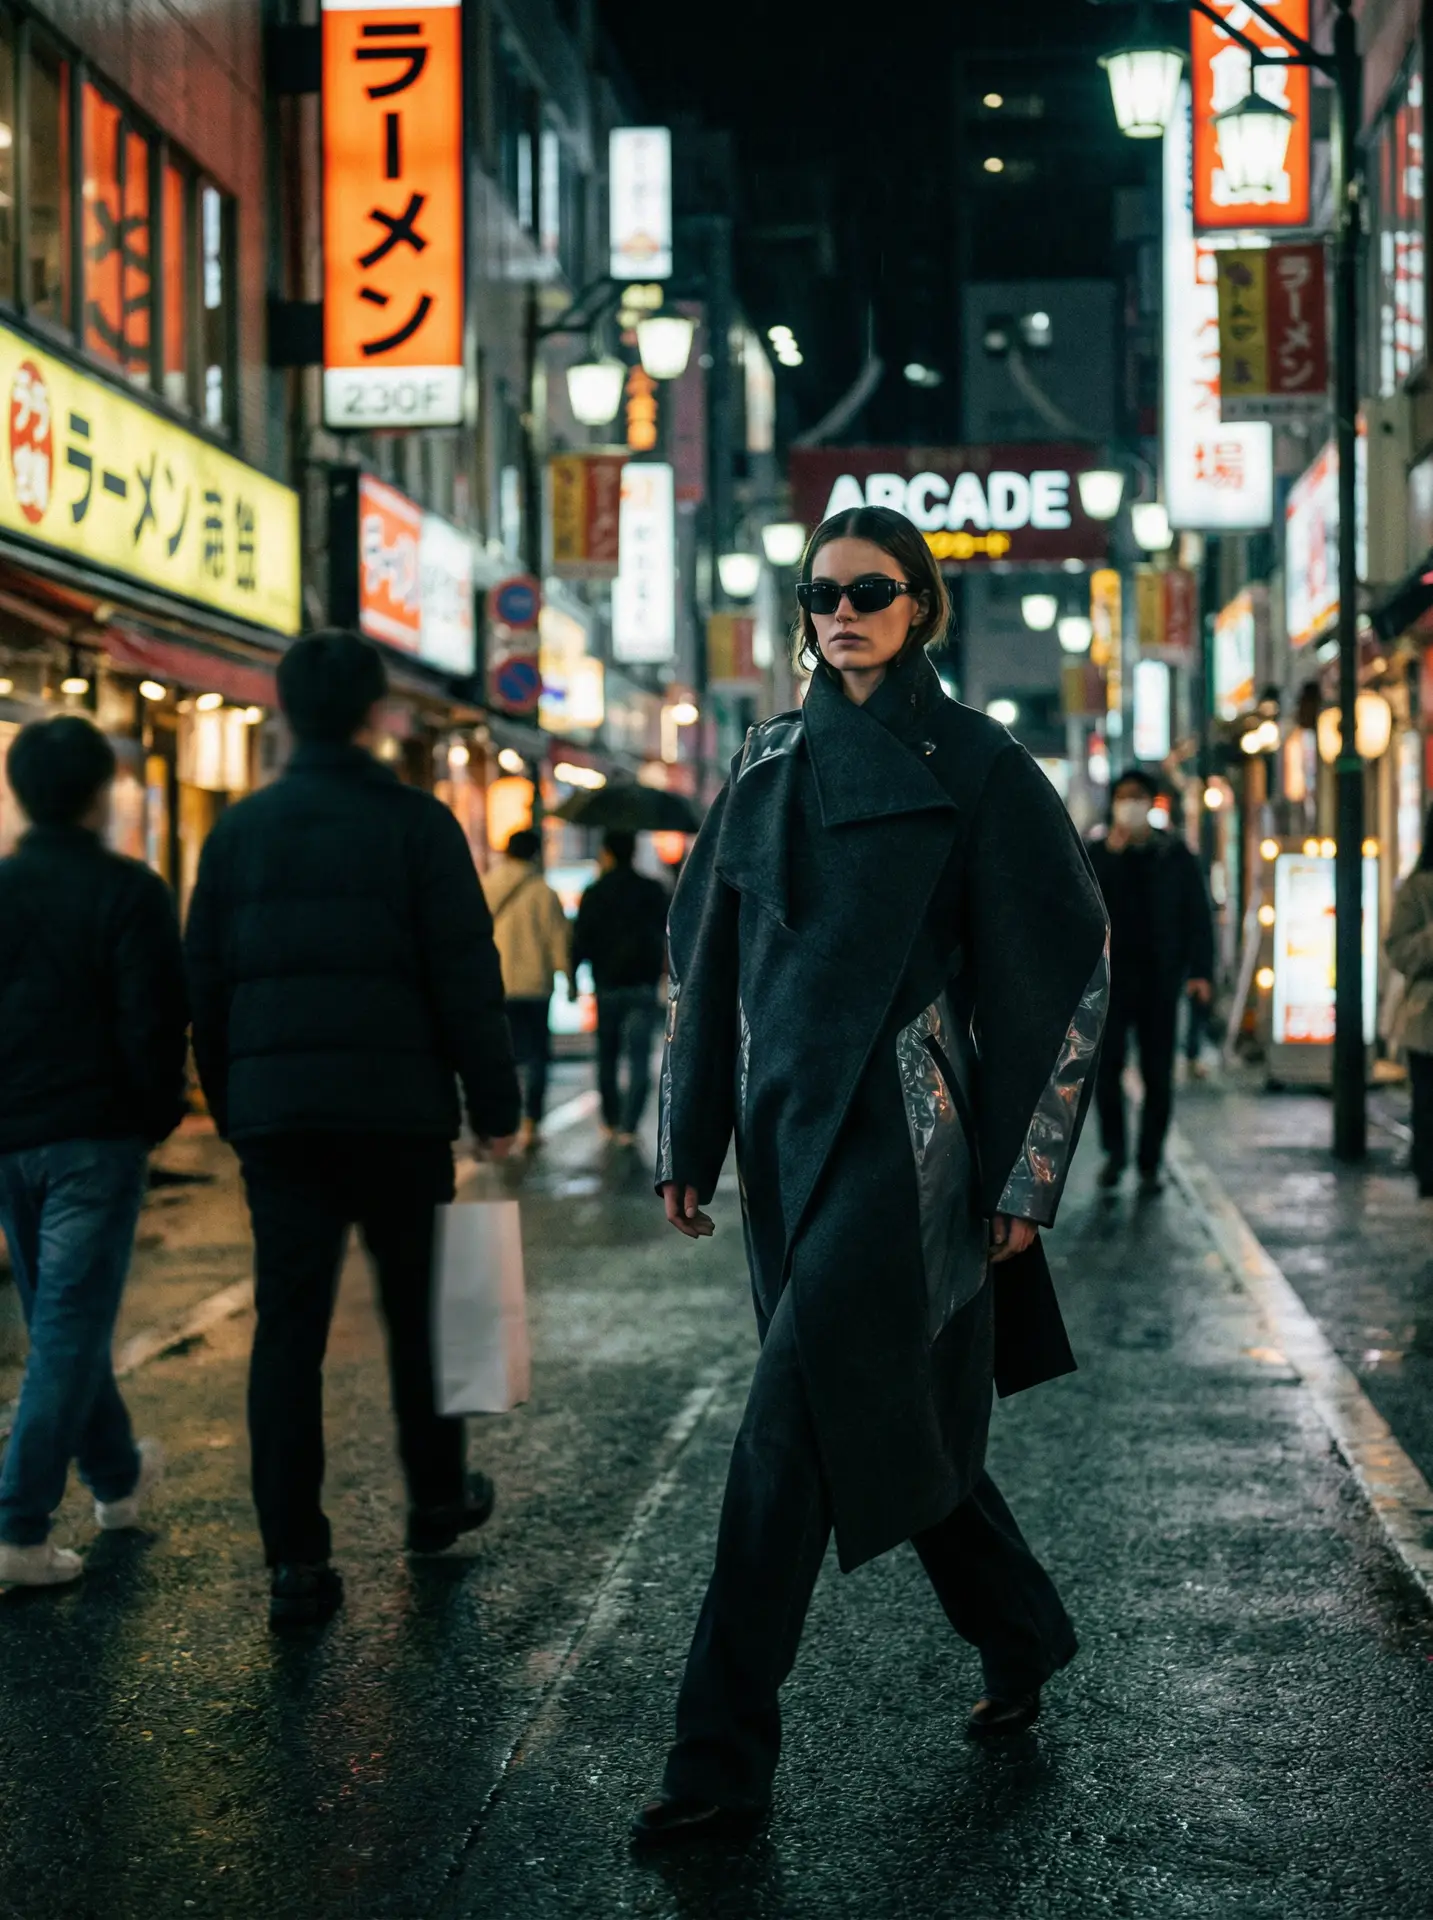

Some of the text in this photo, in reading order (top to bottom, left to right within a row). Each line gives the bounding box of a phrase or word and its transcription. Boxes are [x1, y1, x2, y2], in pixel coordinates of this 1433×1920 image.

[355, 23, 433, 357] ラーメン
[1277, 255, 1316, 388] ラーメン
[66, 411, 191, 557] ラーメン
[822, 470, 1072, 531] ARCADE
